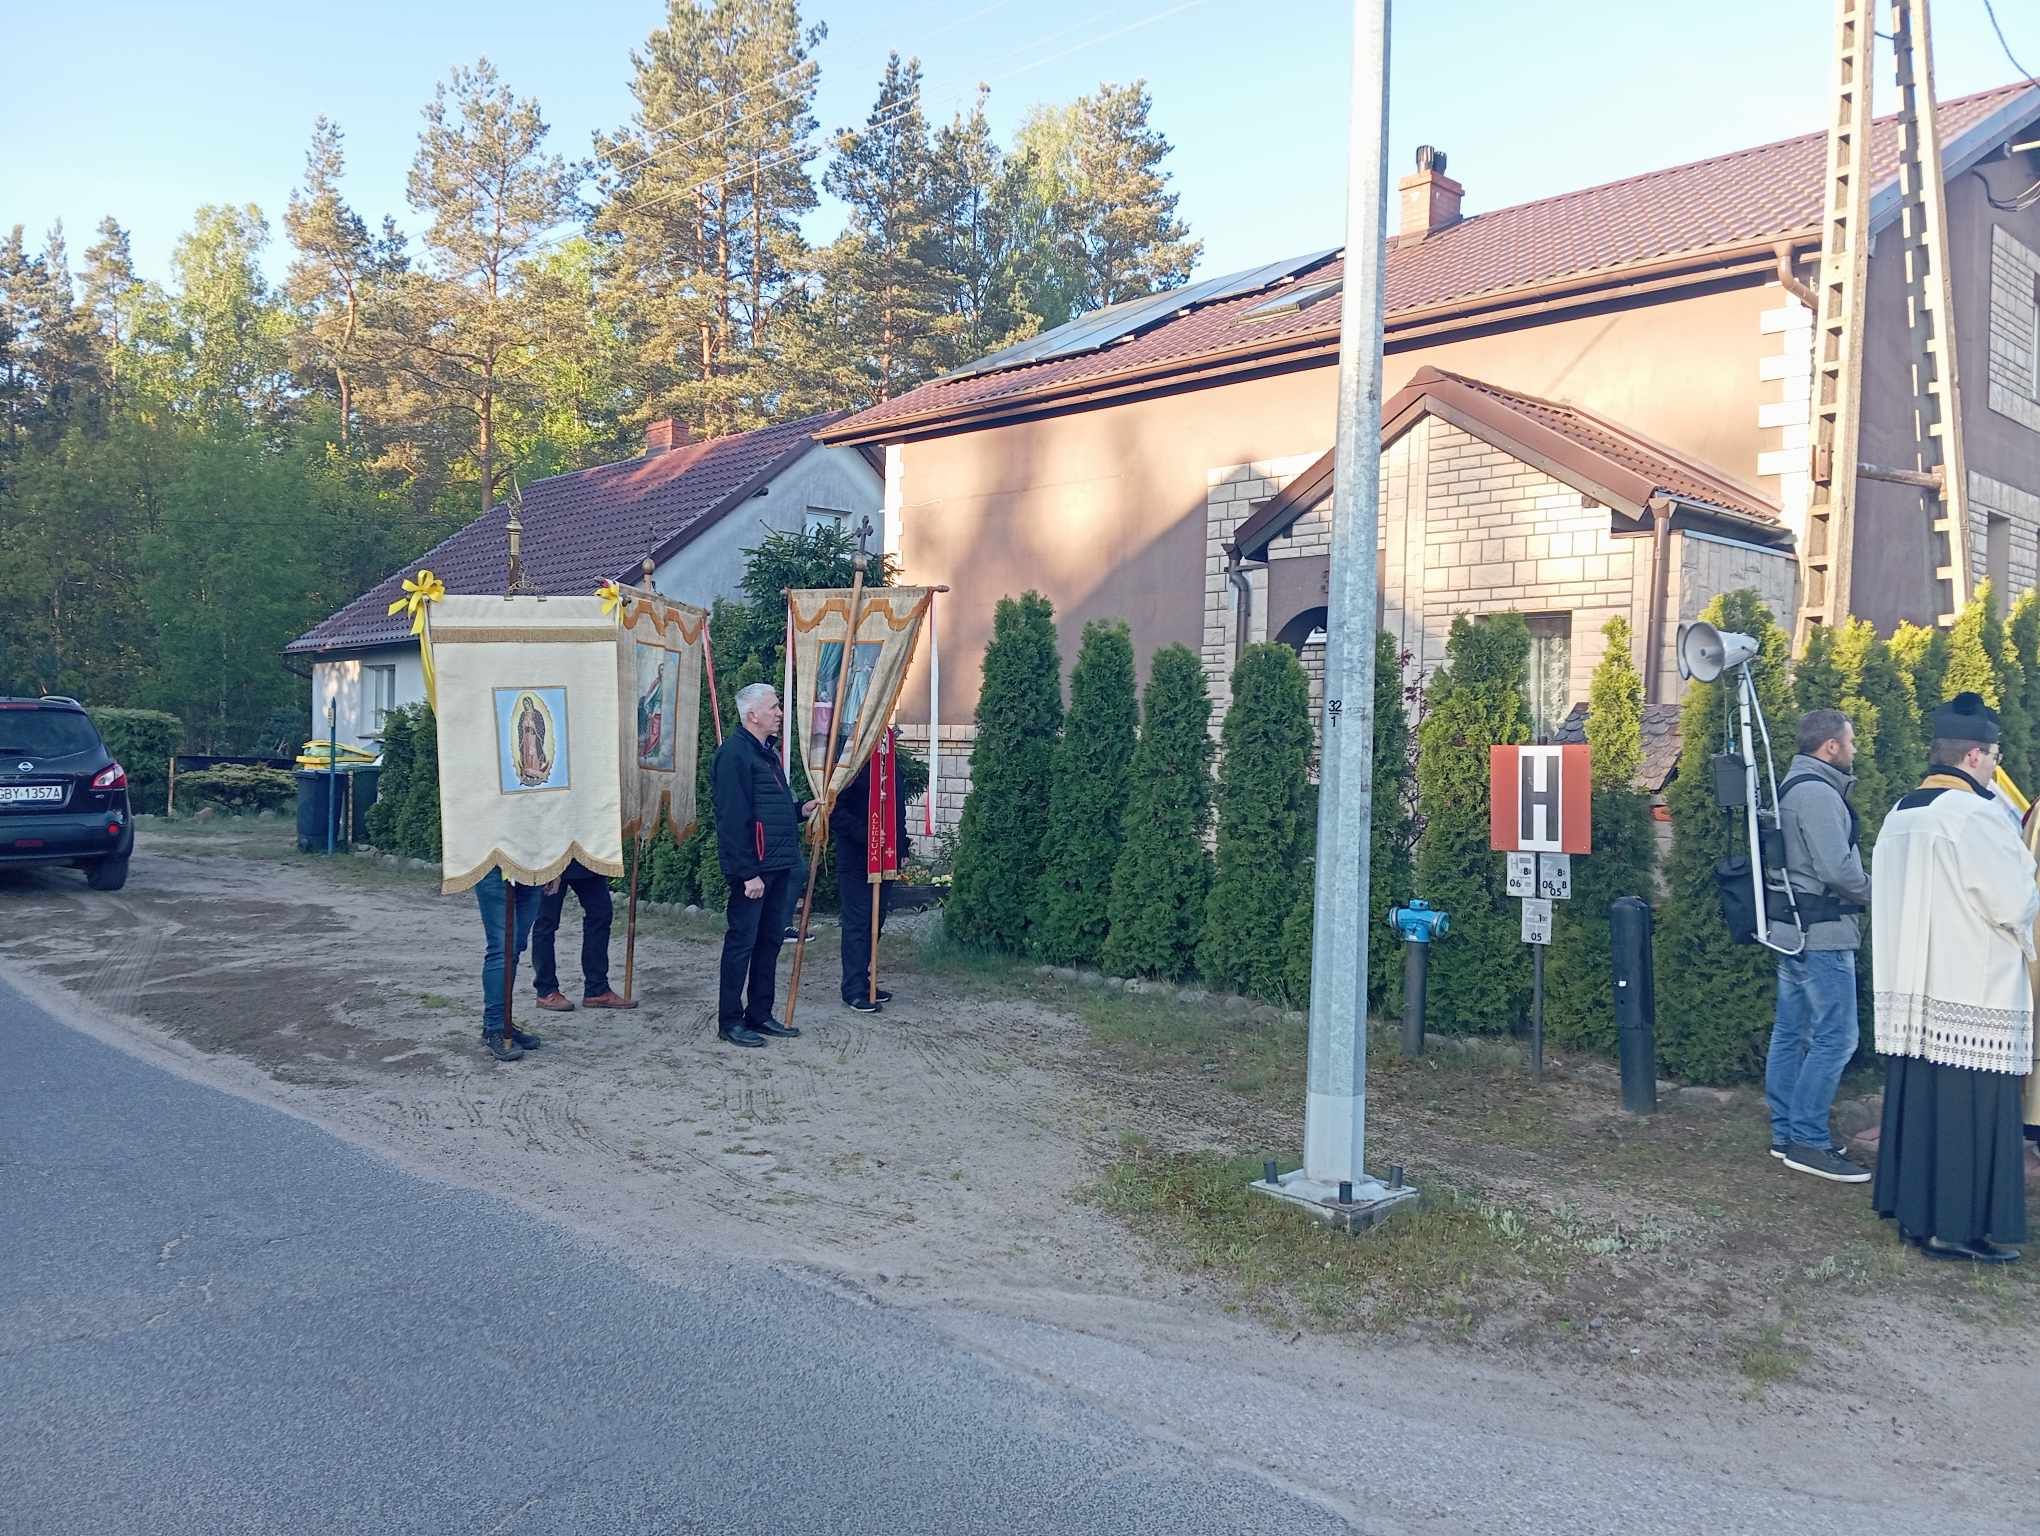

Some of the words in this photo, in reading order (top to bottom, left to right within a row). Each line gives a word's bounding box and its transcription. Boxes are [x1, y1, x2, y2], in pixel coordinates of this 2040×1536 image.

[1328, 700, 1343, 712] 32
[1330, 716, 1336, 727] 1
[0, 788, 20, 799] GBY
[25, 787, 60, 799] 1357A
[1521, 756, 1560, 841] H
